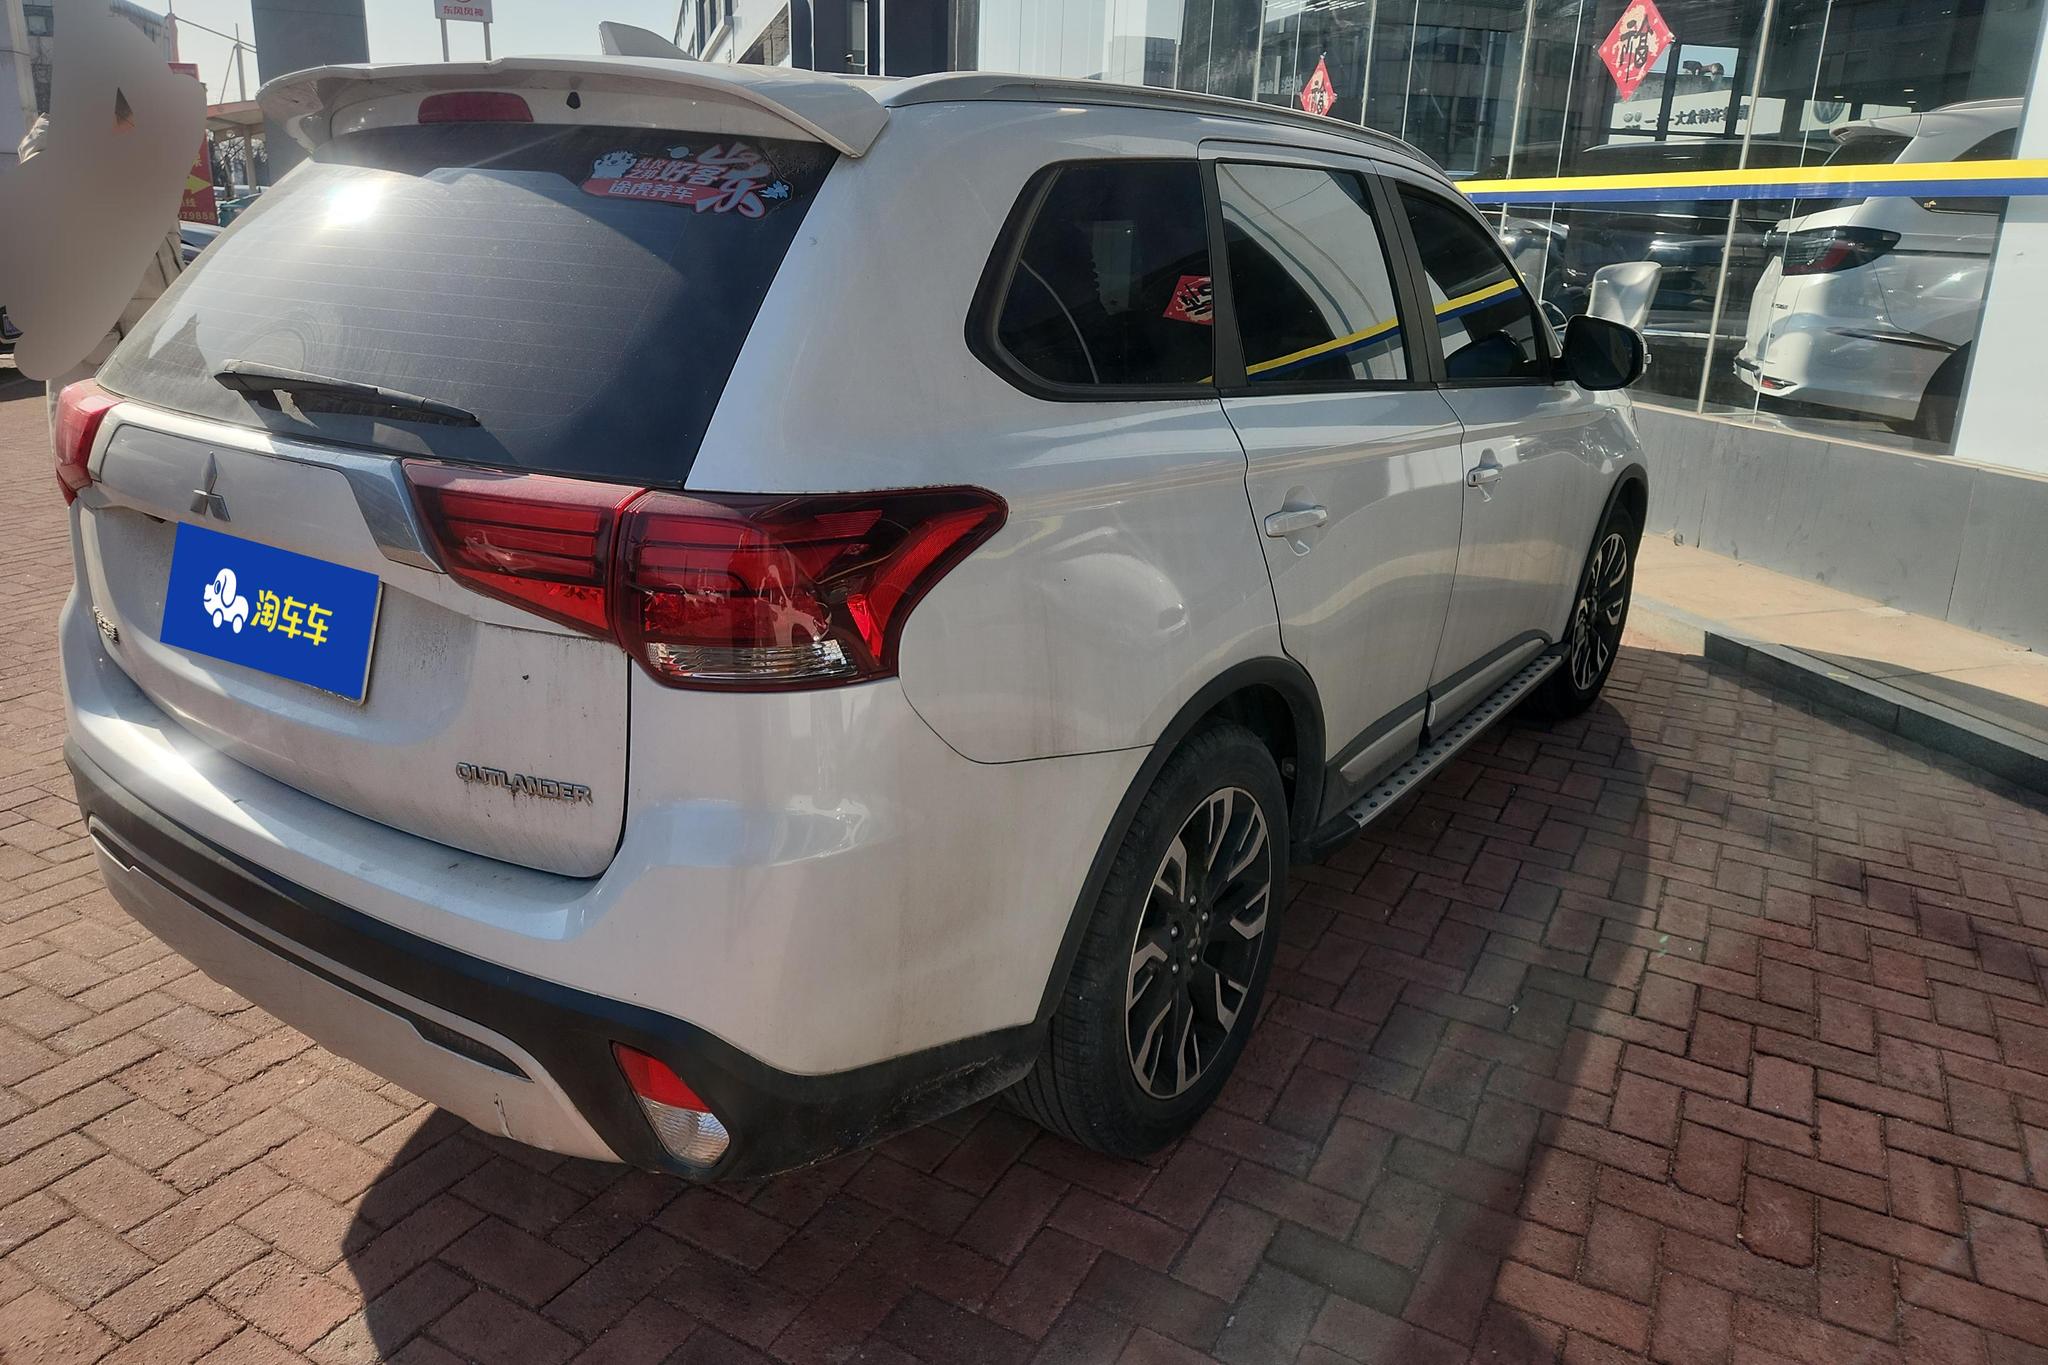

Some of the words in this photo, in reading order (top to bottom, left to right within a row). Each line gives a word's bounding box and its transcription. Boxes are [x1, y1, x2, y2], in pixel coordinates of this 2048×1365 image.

[1620, 14, 1654, 83] 福
[608, 180, 697, 200] 途虎养车
[660, 160, 729, 187] 好客
[456, 762, 594, 807] OUTLANDER
